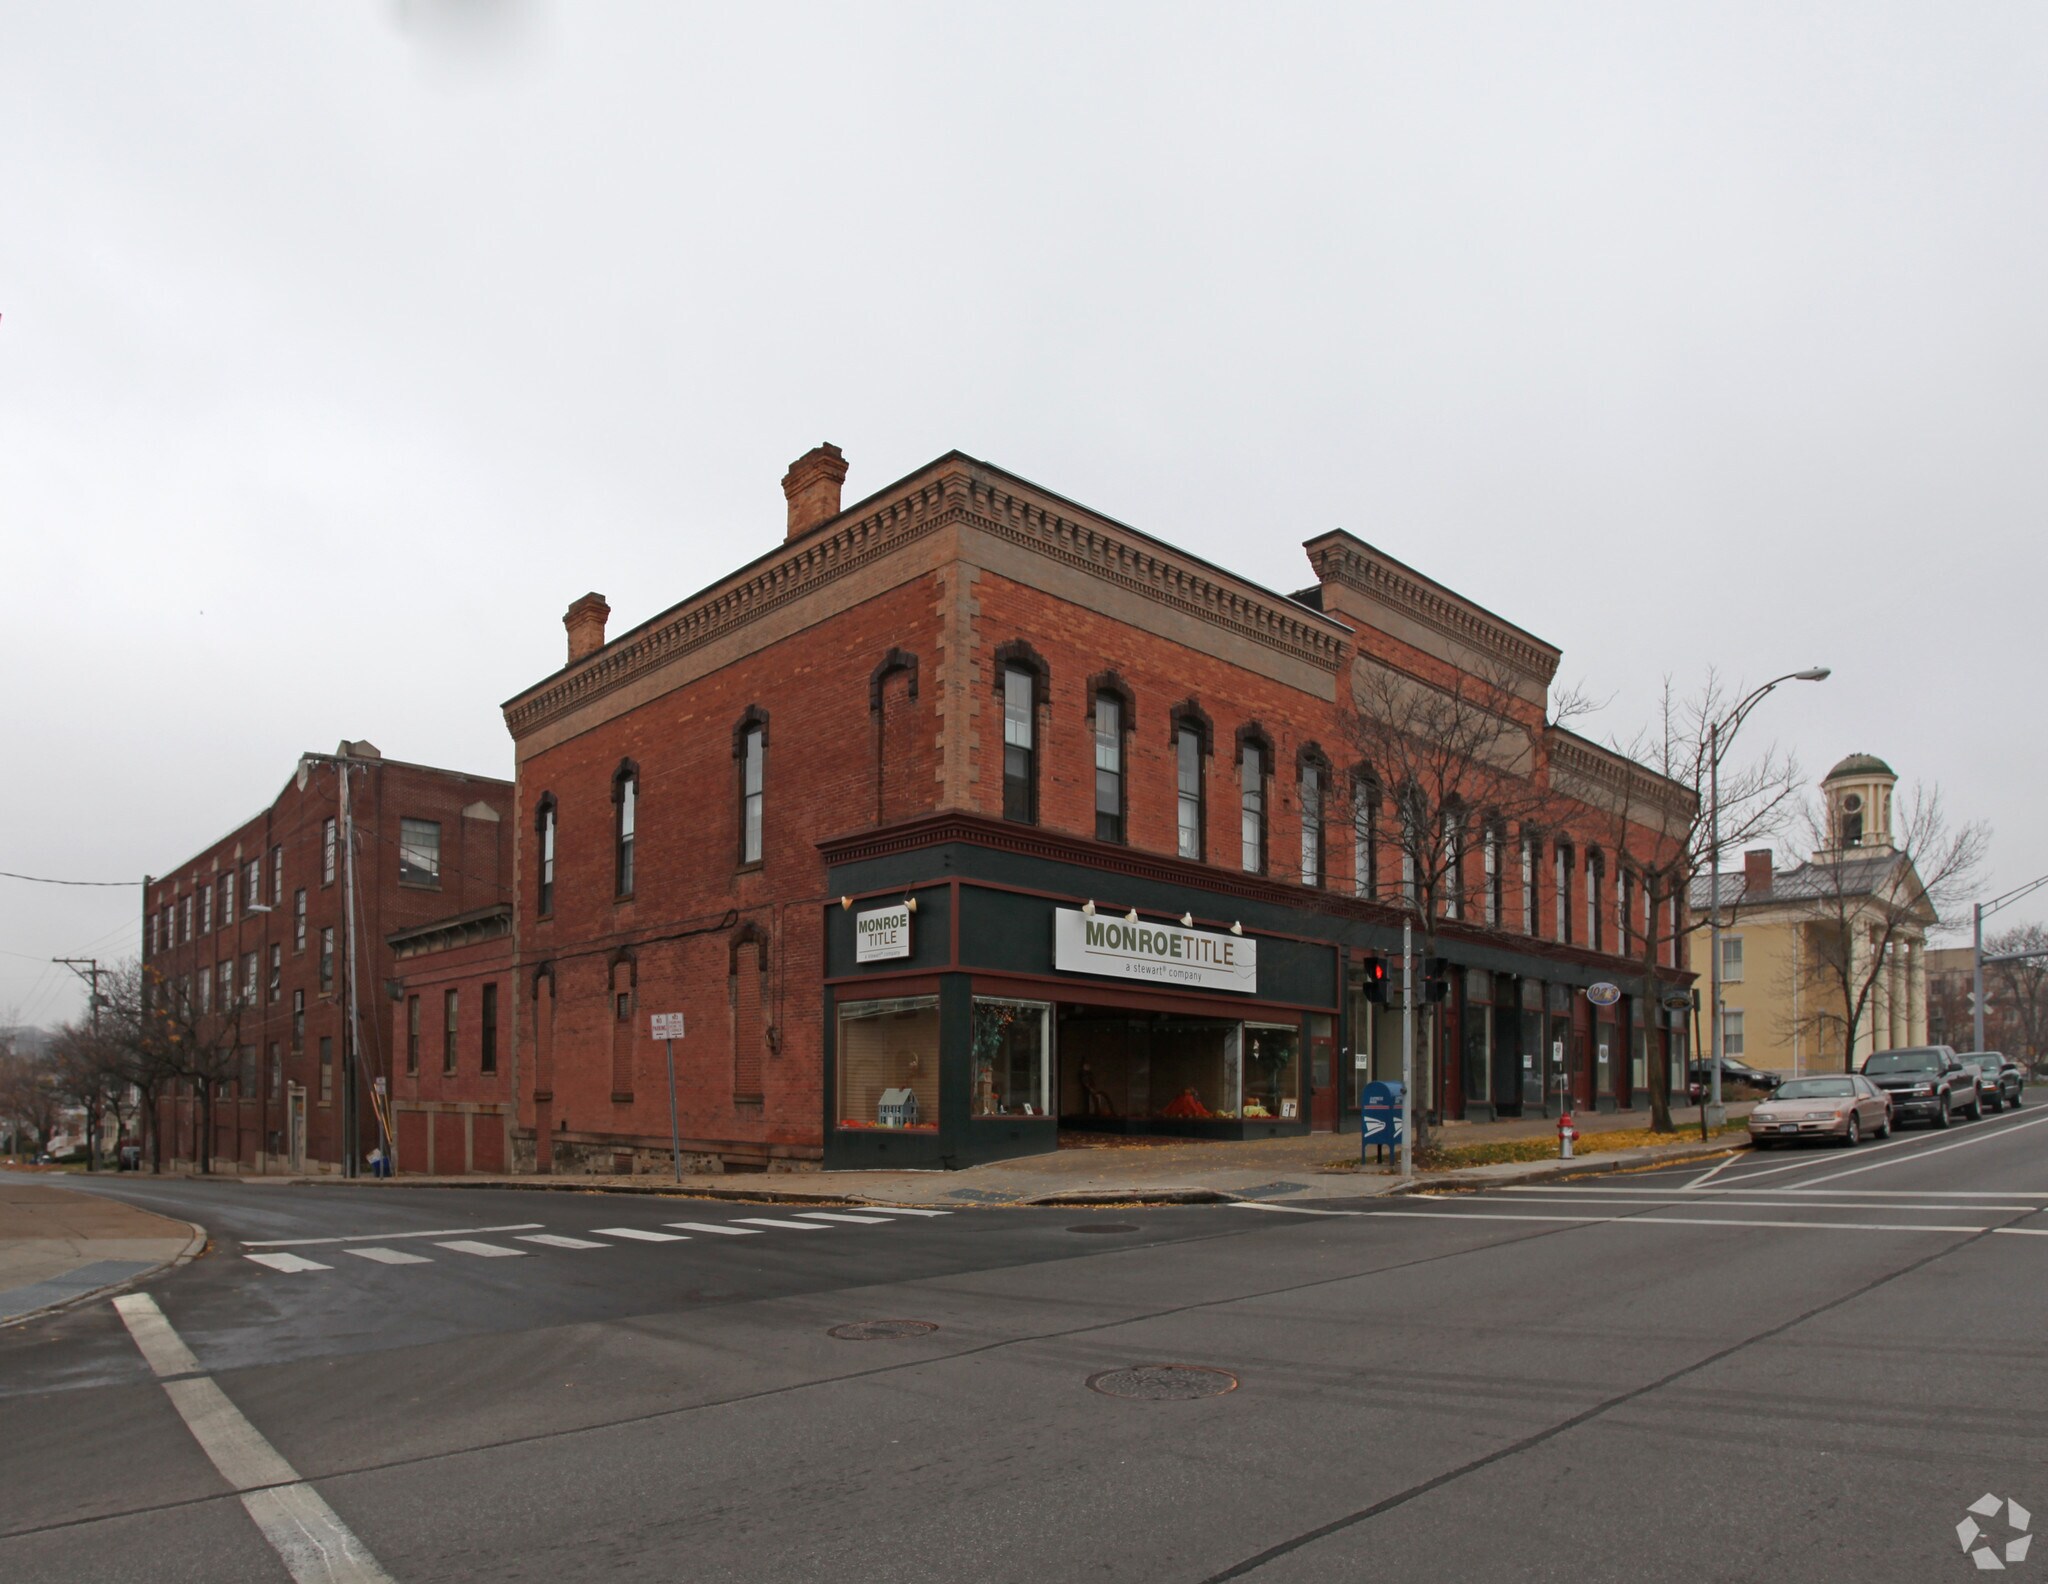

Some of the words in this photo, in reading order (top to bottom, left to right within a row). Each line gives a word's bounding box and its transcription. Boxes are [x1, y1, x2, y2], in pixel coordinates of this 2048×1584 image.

[859, 914, 907, 934] MONROE
[868, 930, 897, 947] TITLE
[1125, 962, 1131, 972] a
[1168, 969, 1203, 982] company
